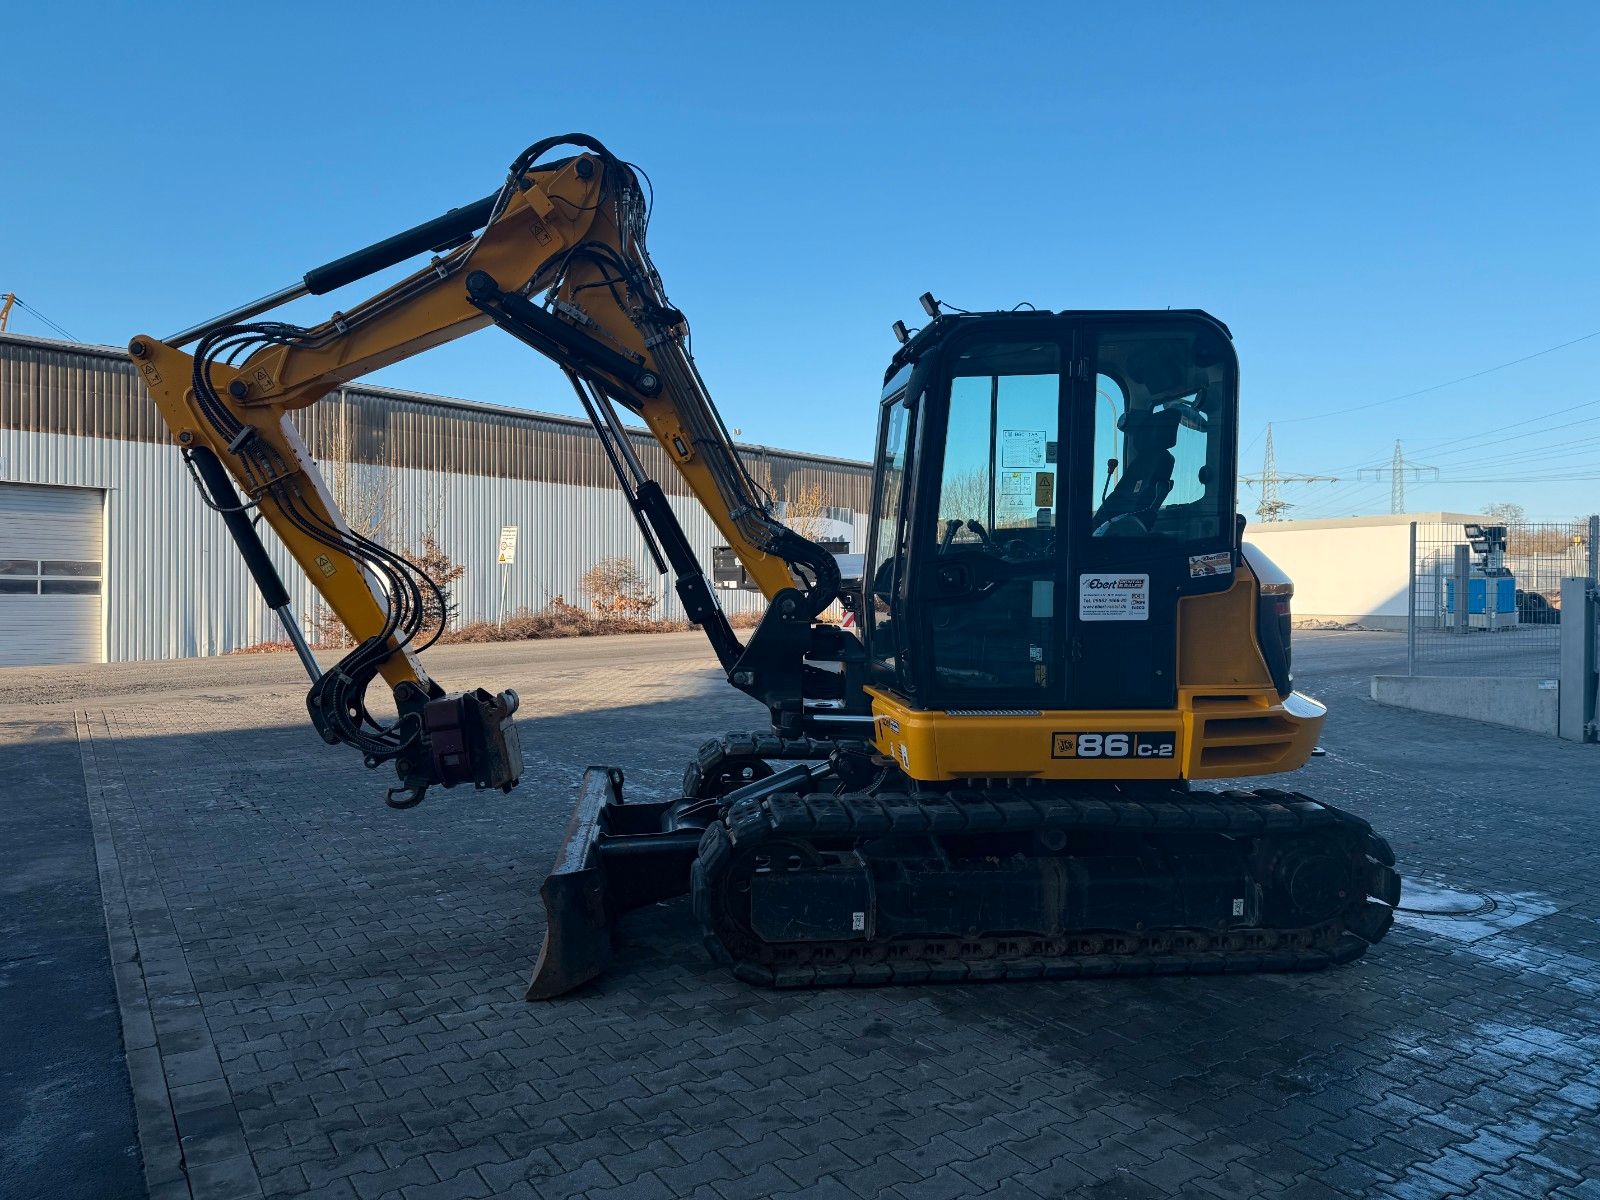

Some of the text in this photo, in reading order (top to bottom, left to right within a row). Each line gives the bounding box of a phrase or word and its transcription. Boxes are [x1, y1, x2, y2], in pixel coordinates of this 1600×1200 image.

[1089, 578, 1118, 589] Ebert
[1077, 733, 1129, 757] 86
[1137, 743, 1173, 757] C-2
